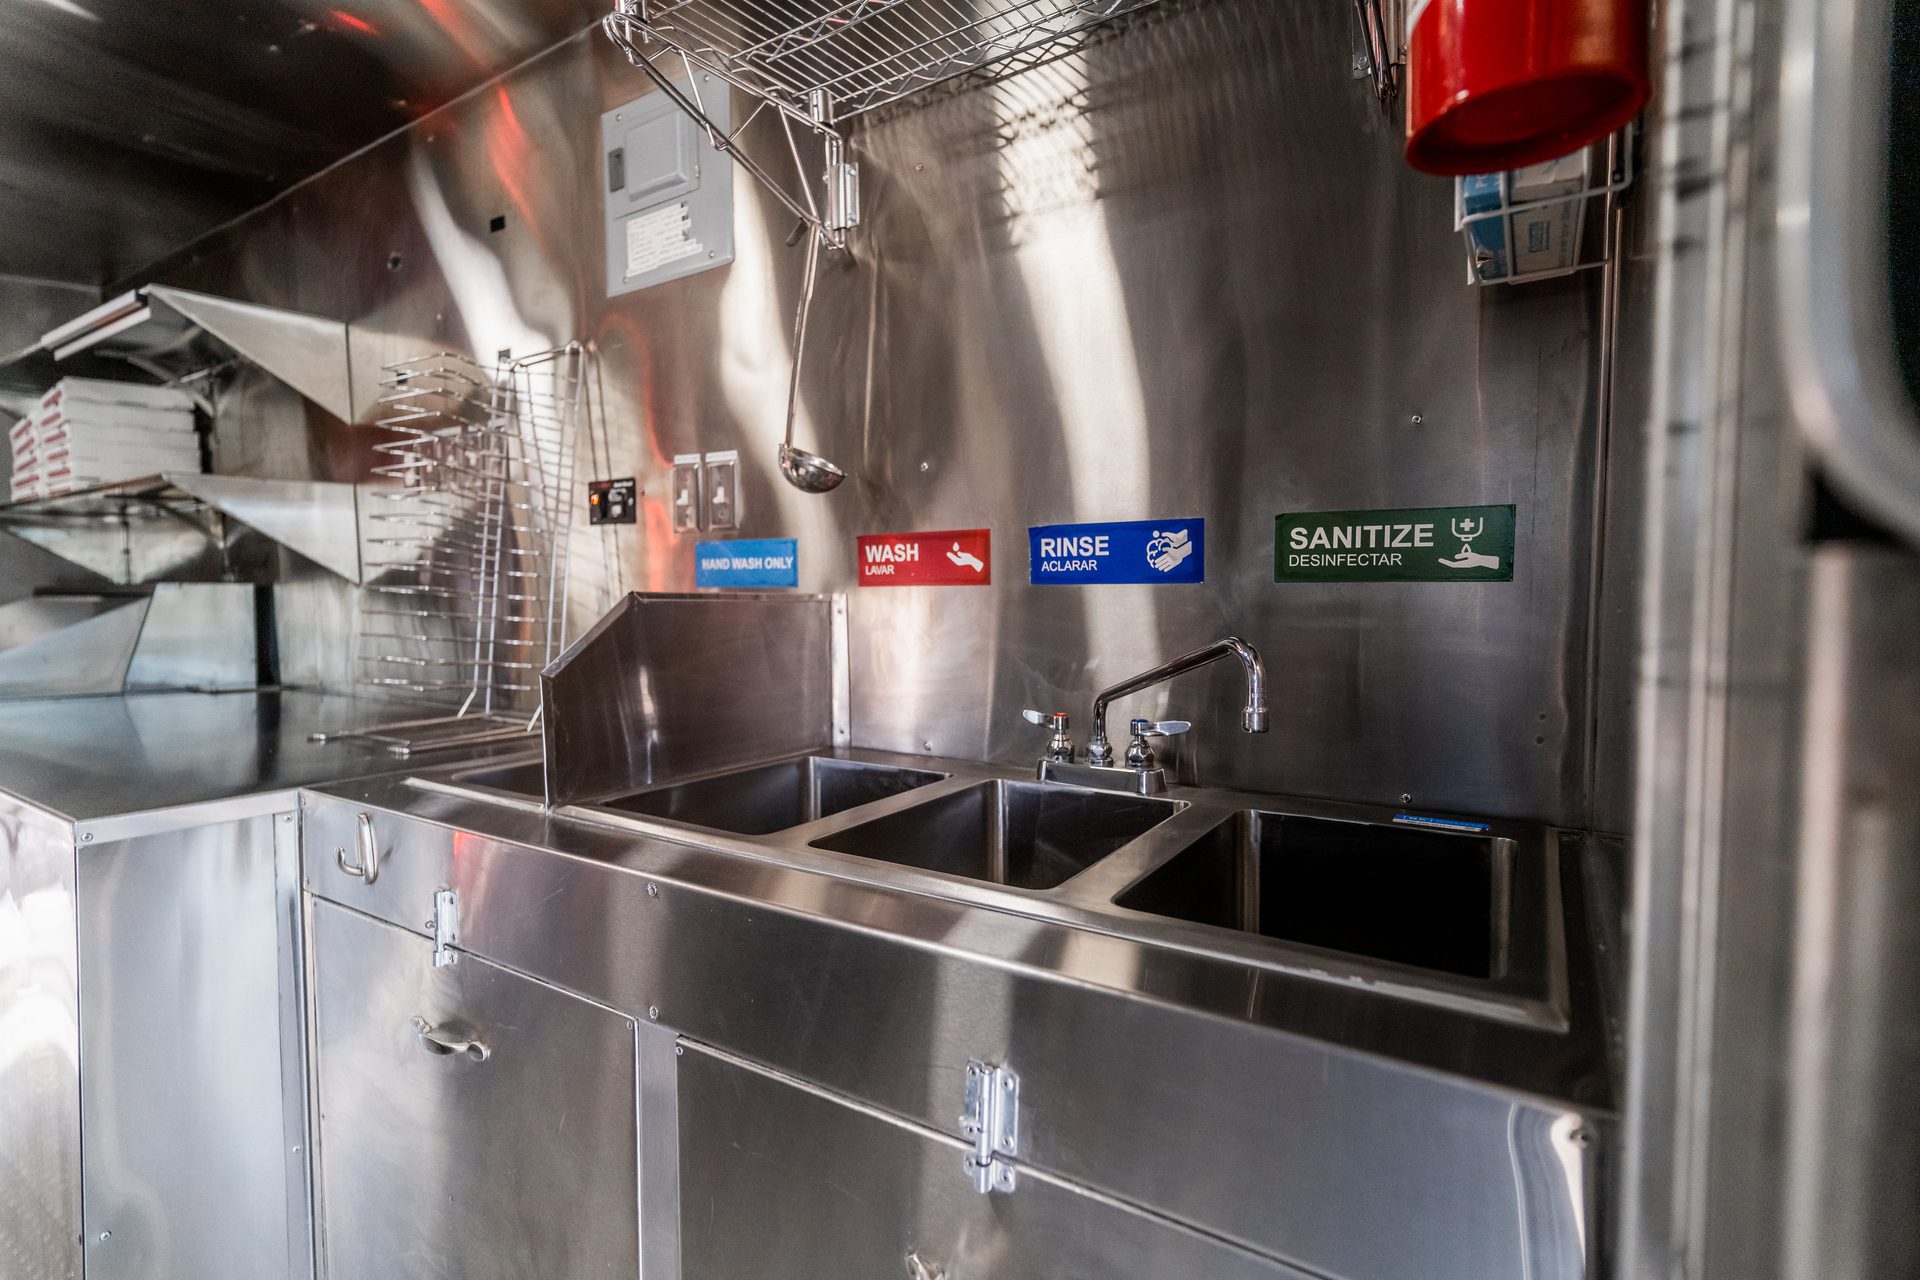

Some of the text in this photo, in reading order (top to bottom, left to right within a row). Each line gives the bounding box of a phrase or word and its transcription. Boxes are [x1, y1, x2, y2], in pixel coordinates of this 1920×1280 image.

[1289, 523, 1434, 550] SANITIZE
[865, 543, 920, 563] WASH
[1040, 535, 1110, 558] RINSE
[701, 555, 794, 570] HAND WASH ONLY
[1041, 559, 1099, 572] ACLARAR
[1288, 553, 1403, 567] DESINFECTAR
[865, 564, 896, 576] LAVAR
